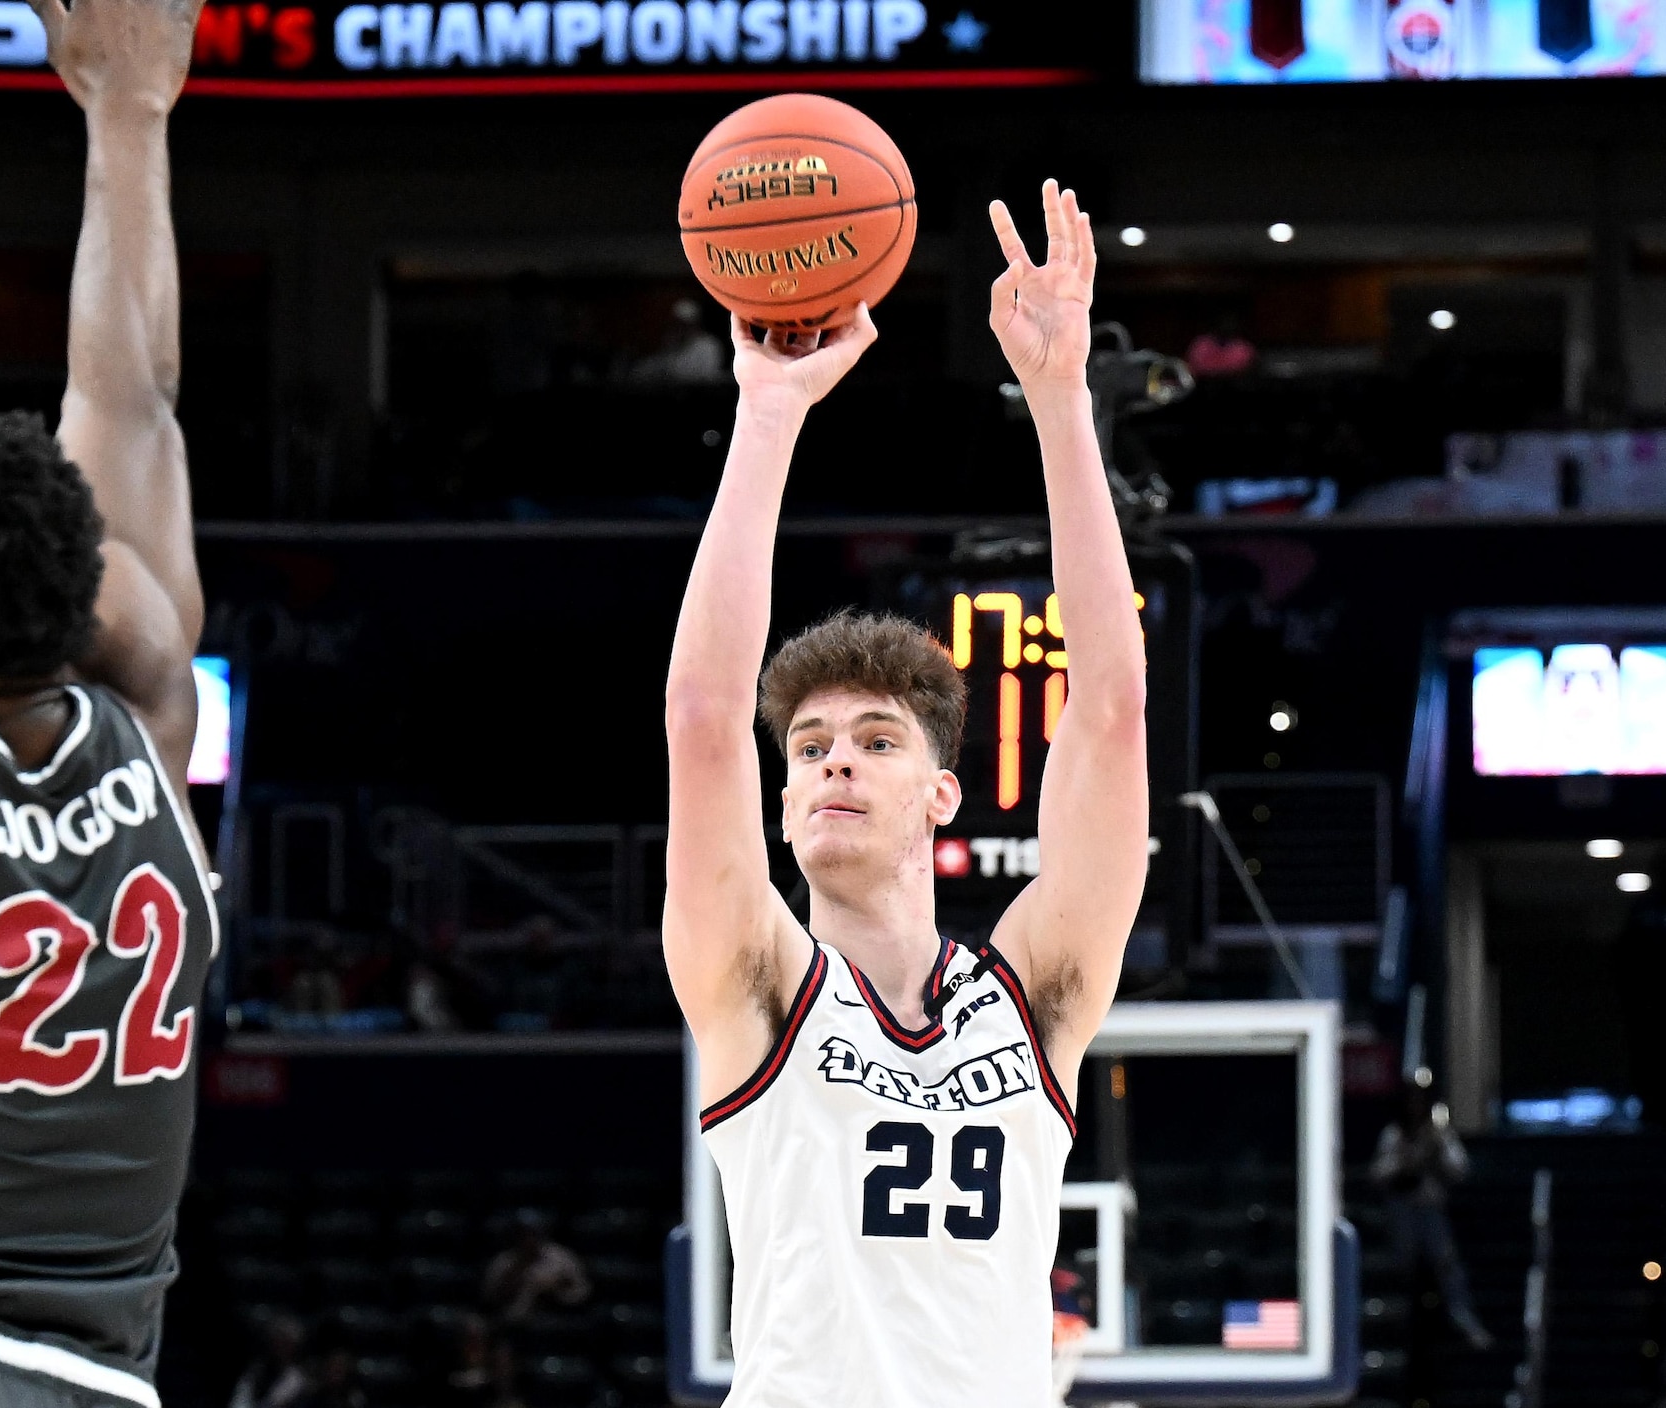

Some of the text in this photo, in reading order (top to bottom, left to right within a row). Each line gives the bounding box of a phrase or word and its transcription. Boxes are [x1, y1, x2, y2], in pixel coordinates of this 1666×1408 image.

[193, 2, 316, 68] N'S
[334, 0, 927, 70] CHAMPIONSHIP
[707, 172, 838, 211] LEGACY
[704, 224, 859, 280] SPALDING
[817, 1035, 1036, 1112] DAYTON
[861, 1120, 1006, 1241] 29
